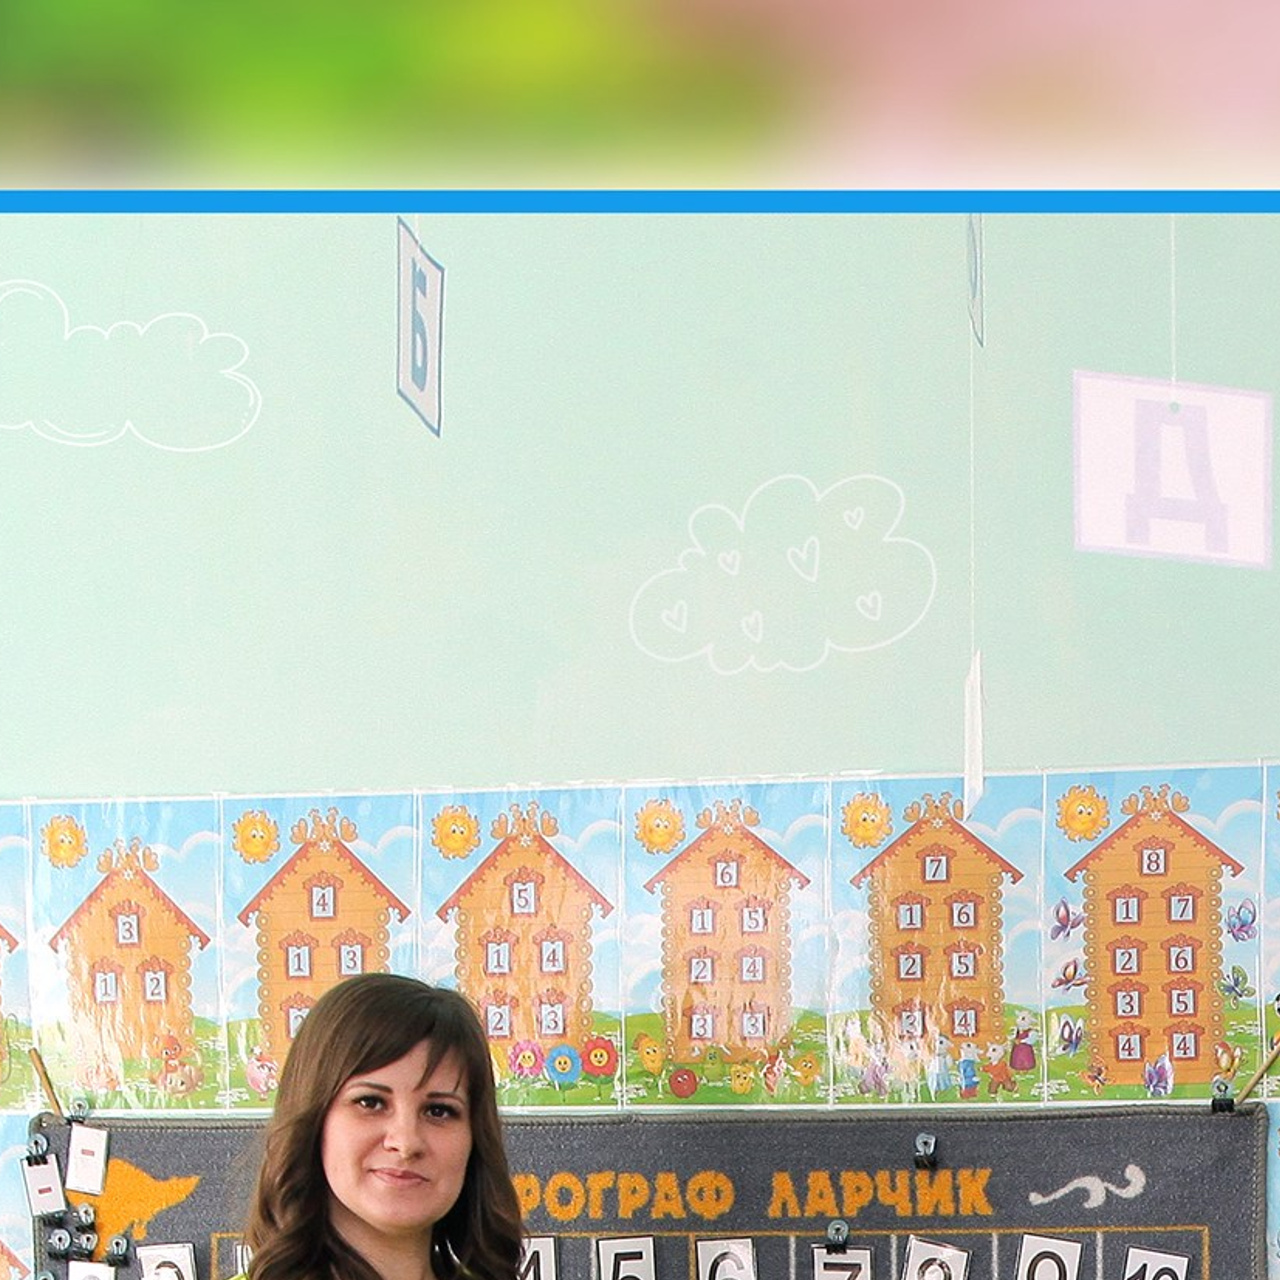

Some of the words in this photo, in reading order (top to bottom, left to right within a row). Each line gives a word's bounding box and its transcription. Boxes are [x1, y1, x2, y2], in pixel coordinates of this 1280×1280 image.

[929, 858, 942, 879] 7
[1146, 851, 1161, 873] 8
[316, 892, 329, 912] 4
[517, 887, 529, 909] 5
[903, 905, 917, 927] 1
[957, 903, 971, 925] 6
[1121, 899, 1133, 921] 1
[1177, 898, 1190, 918] 7
[122, 921, 134, 940] 3
[293, 952, 304, 972] 1
[346, 949, 357, 970] 3
[494, 949, 504, 969] 1
[546, 948, 559, 968] 4
[903, 954, 917, 976] 2
[957, 954, 970, 975] 5
[1121, 949, 1135, 971] 2
[1174, 949, 1189, 971] 6
[102, 977, 111, 997] 1
[149, 977, 161, 997] 2
[1121, 992, 1135, 1014] 3
[1175, 991, 1189, 1013] 5
[492, 1011, 504, 1031] 2
[547, 1009, 559, 1031] 3
[1120, 1037, 1135, 1057] 4
[1176, 1035, 1190, 1056] 4
[767, 1167, 994, 1219] ЛАРЧИК
